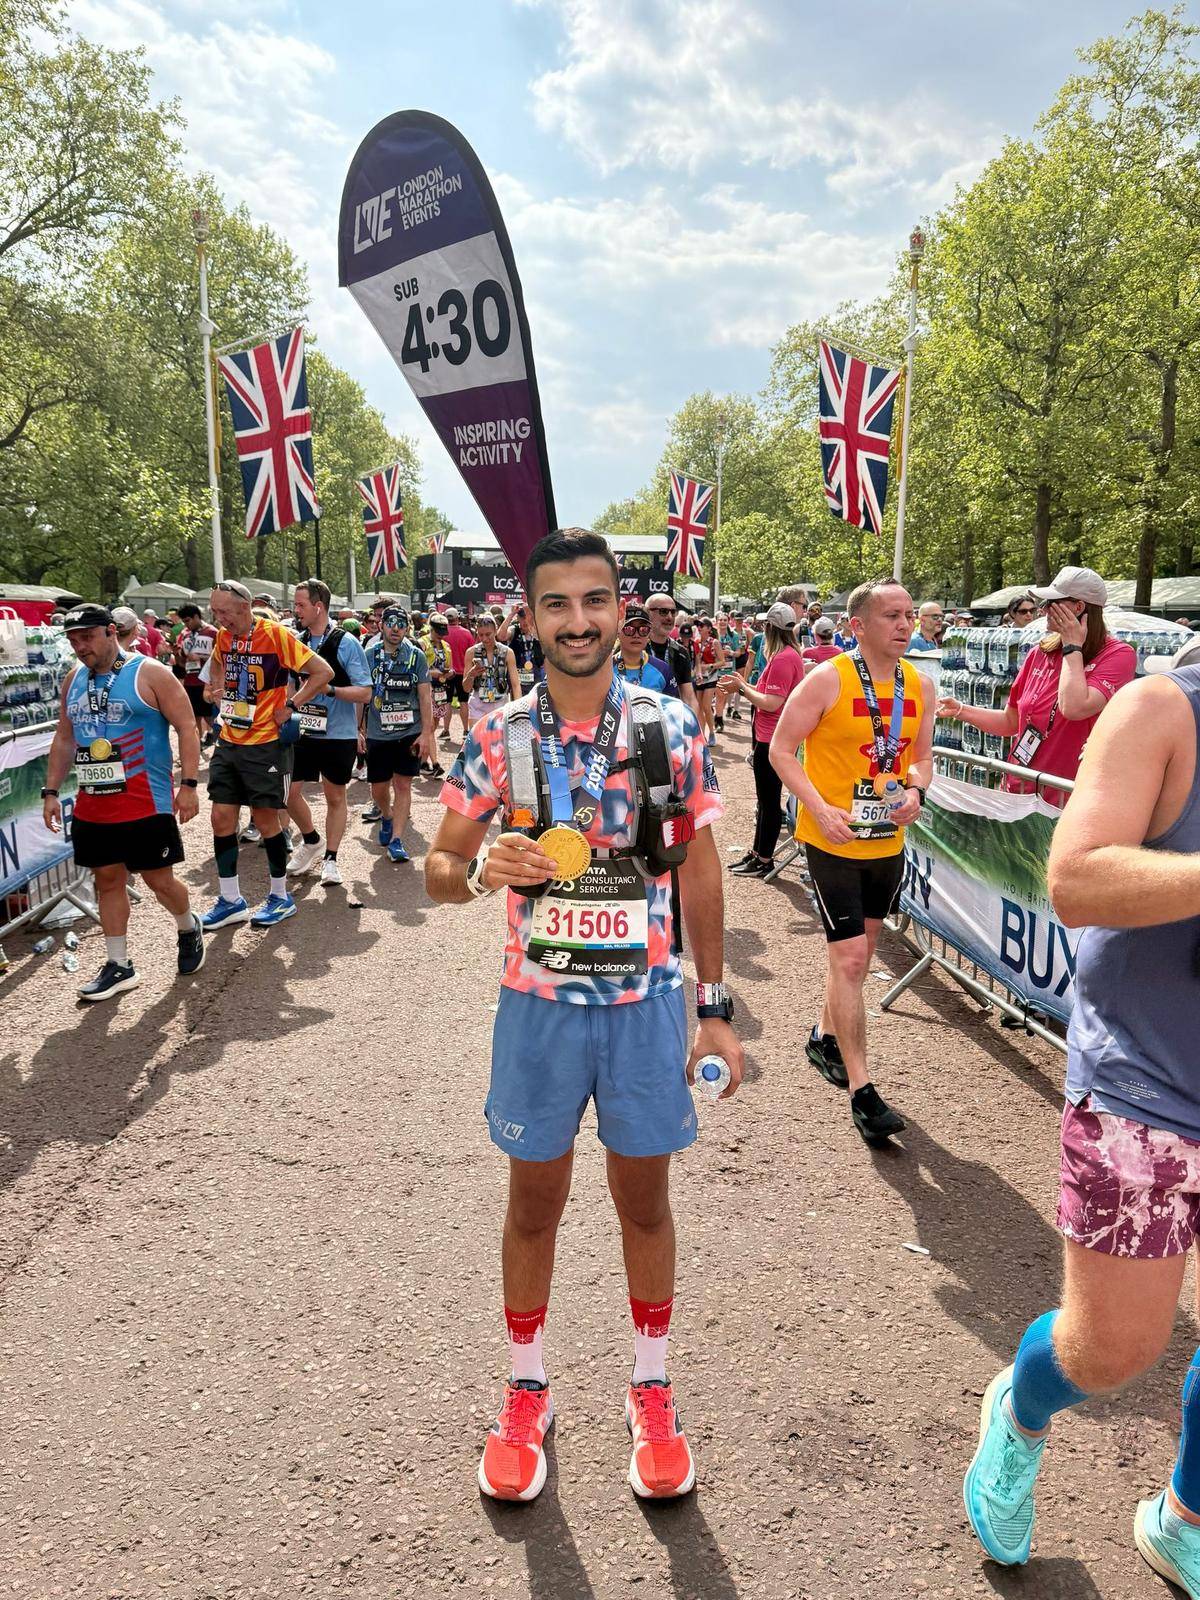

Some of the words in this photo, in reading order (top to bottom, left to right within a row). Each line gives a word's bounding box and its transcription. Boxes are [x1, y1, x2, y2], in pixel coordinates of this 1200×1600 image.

[397, 165, 443, 200] LONDON
[399, 173, 462, 215] MARATHON
[401, 201, 441, 230] EVENTS
[393, 277, 419, 302] SUB
[401, 279, 511, 374] 4:30
[453, 418, 531, 446] INSPIRING
[459, 442, 523, 467] ACTIVITY
[458, 574, 479, 588] tcs
[493, 575, 514, 590] tcs
[649, 579, 669, 592] tcs
[386, 678, 410, 687] drew
[540, 693, 549, 711] tcs
[597, 729, 611, 747] tcs
[547, 734, 560, 769] FINISHER
[82, 766, 114, 780] 79680
[586, 753, 607, 791] 2025
[579, 875, 637, 885] CONSULTANCY
[579, 885, 619, 894] SERVICES
[546, 907, 629, 939] 31506
[571, 962, 592, 971] new
[593, 961, 636, 973] balance
